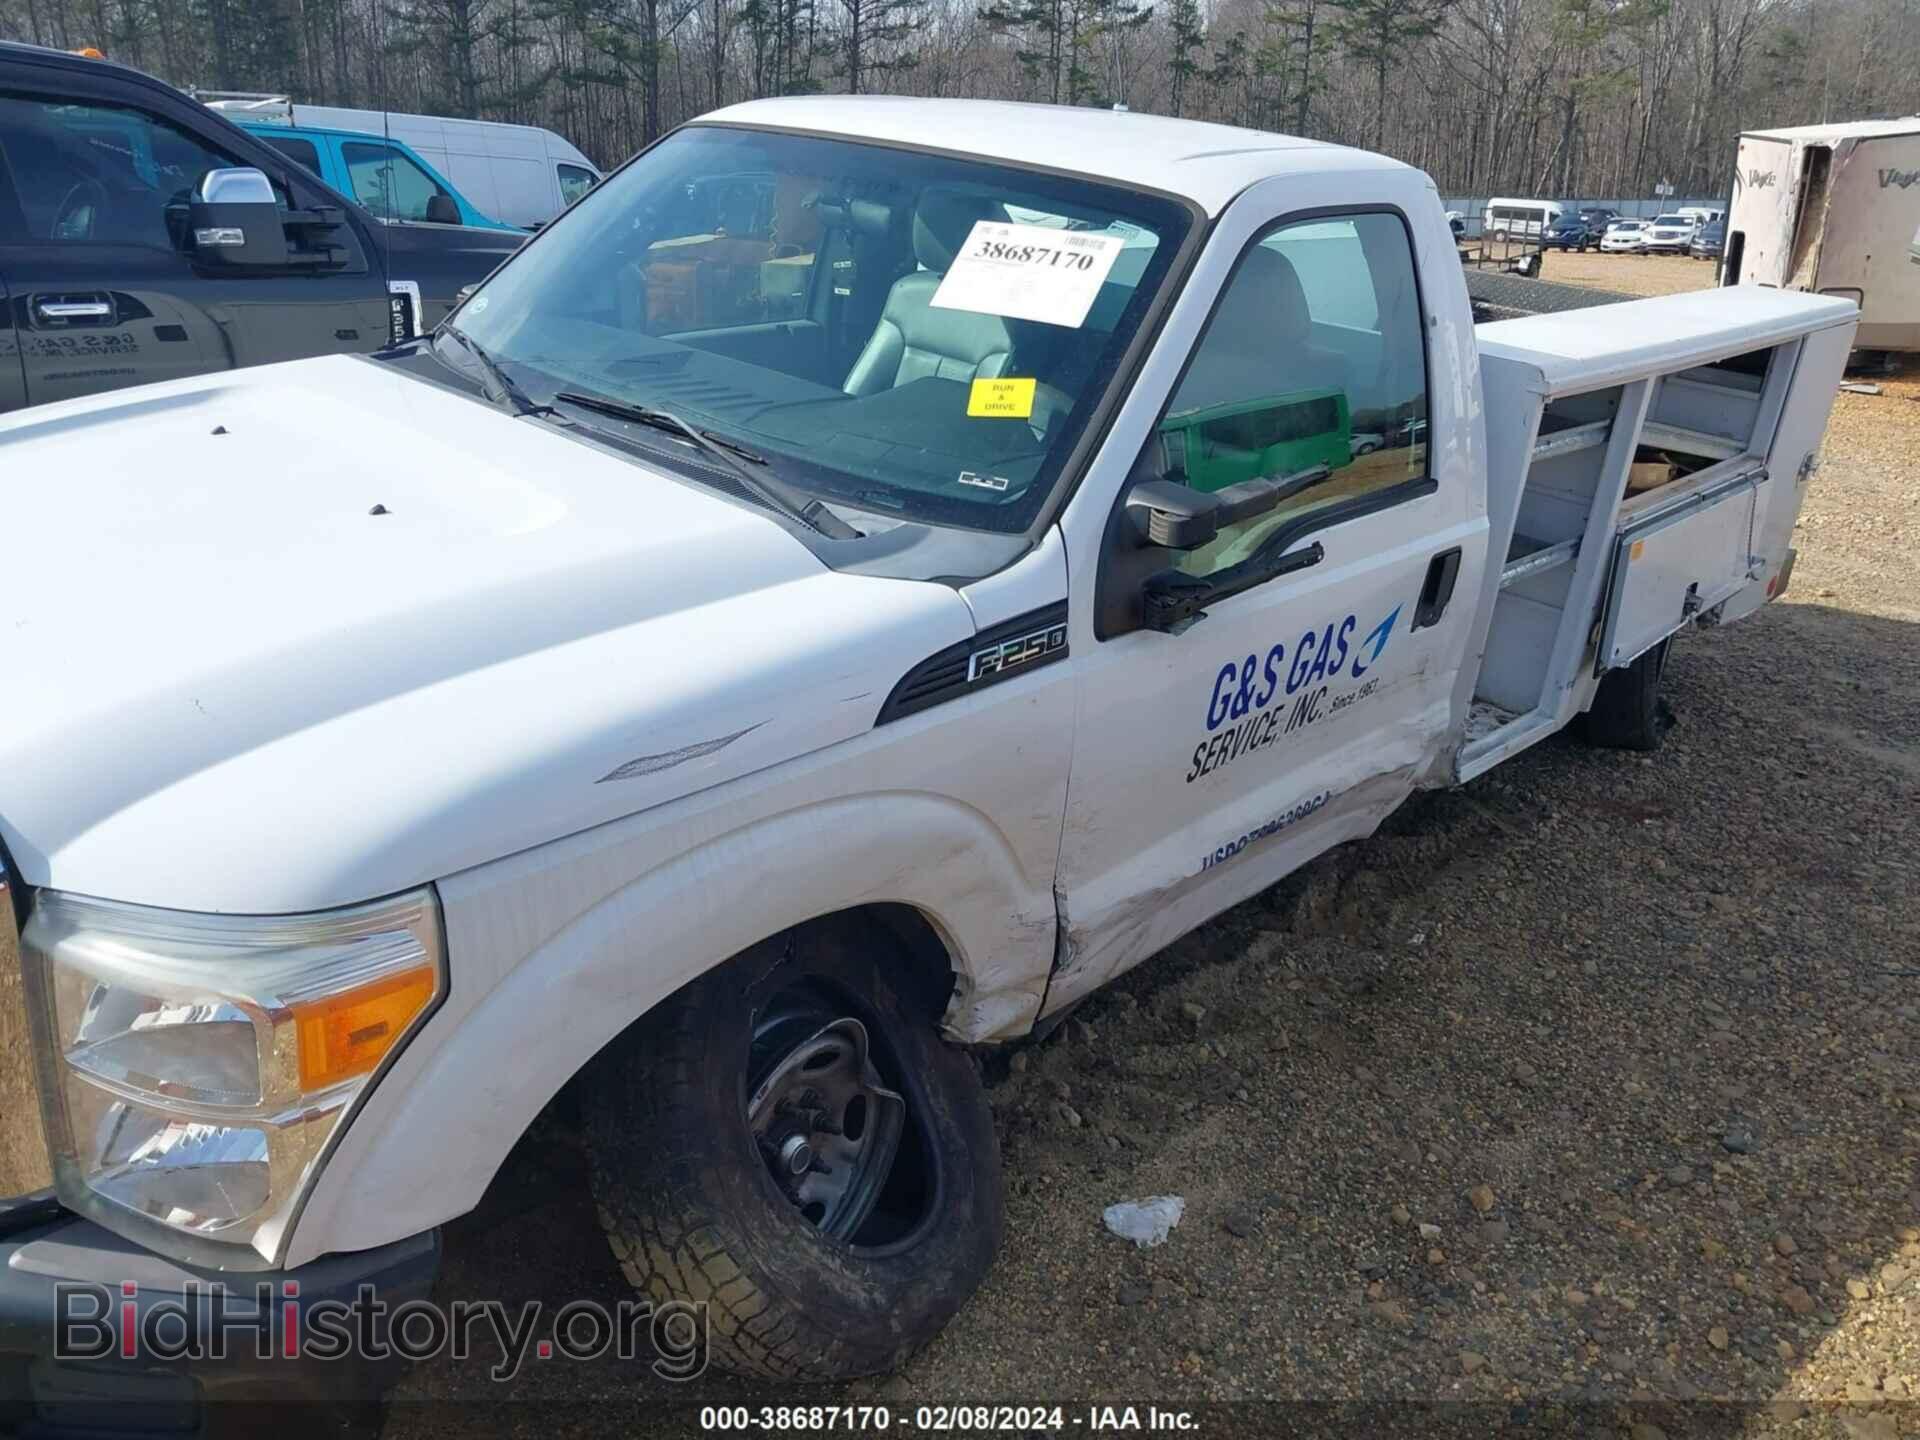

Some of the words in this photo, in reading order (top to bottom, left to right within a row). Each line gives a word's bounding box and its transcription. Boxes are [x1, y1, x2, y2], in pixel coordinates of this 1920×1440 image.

[974, 241, 1094, 271] 38687170
[992, 384, 1015, 392] RUN
[984, 403, 1016, 411] DRIVE
[1206, 643, 1286, 731] G&S
[1285, 614, 1357, 695] GAS
[1186, 704, 1286, 784] SERVICE,
[1283, 685, 1329, 735] INC.
